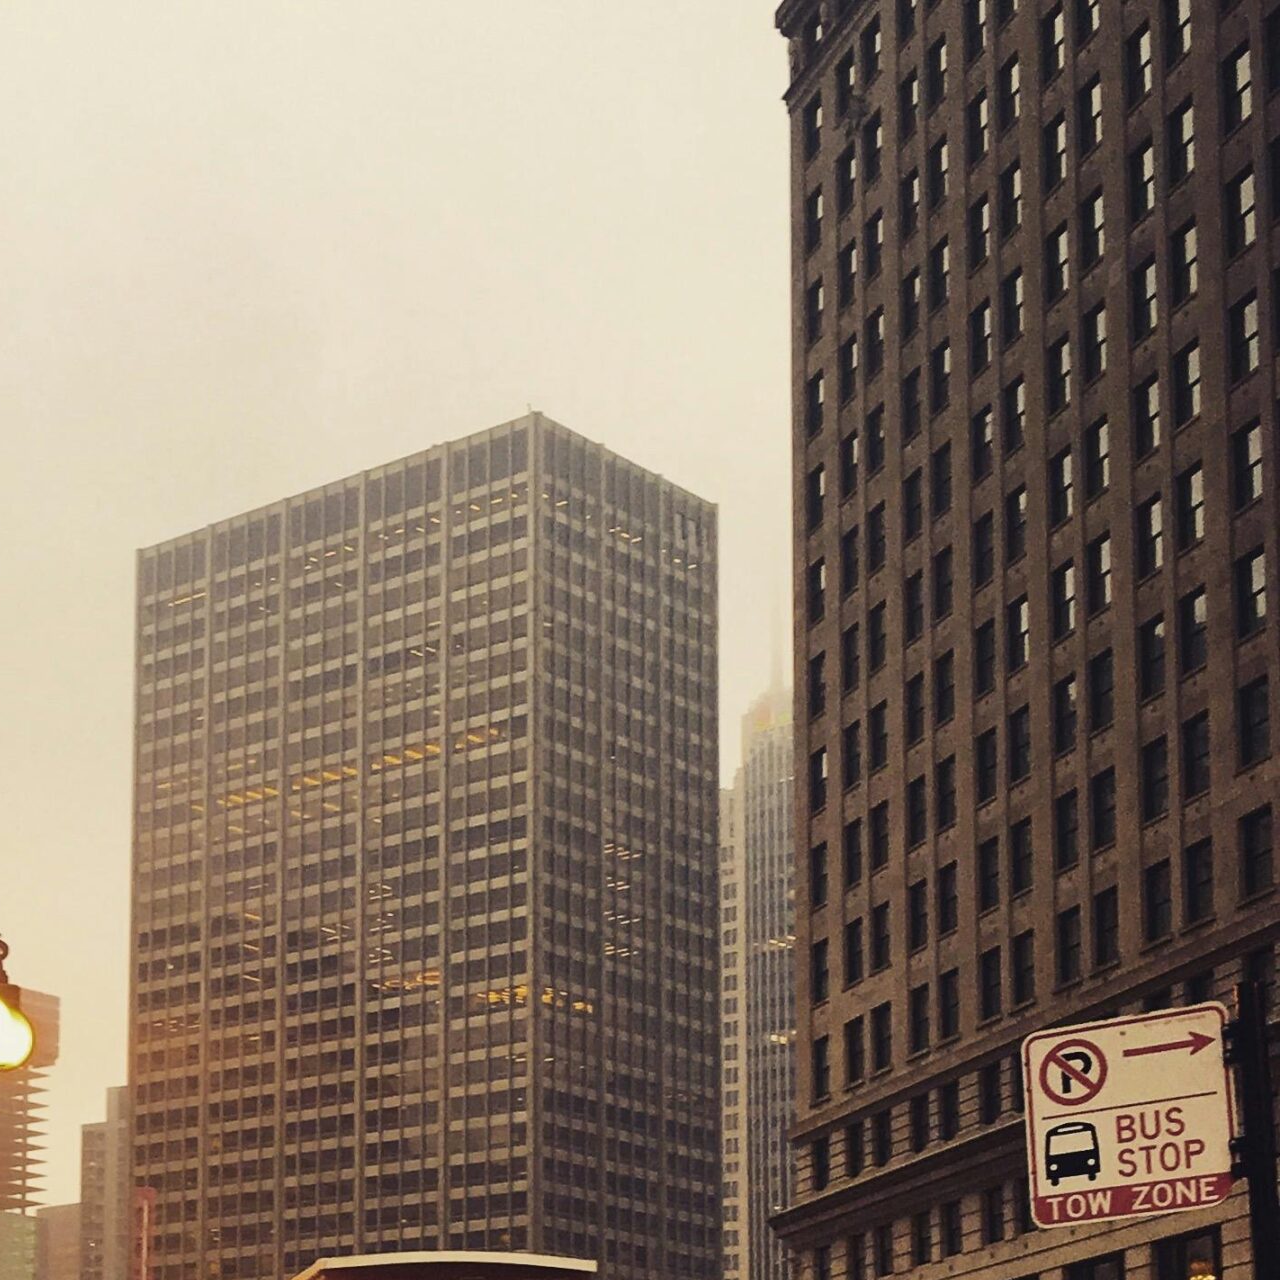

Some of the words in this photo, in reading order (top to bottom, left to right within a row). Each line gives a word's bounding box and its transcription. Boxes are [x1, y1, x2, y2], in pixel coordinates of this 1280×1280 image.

[1116, 1107, 1186, 1144] BUS
[1118, 1139, 1205, 1177] STOP
[1047, 1191, 1112, 1220] TOW
[1132, 1177, 1219, 1211] ZONE
